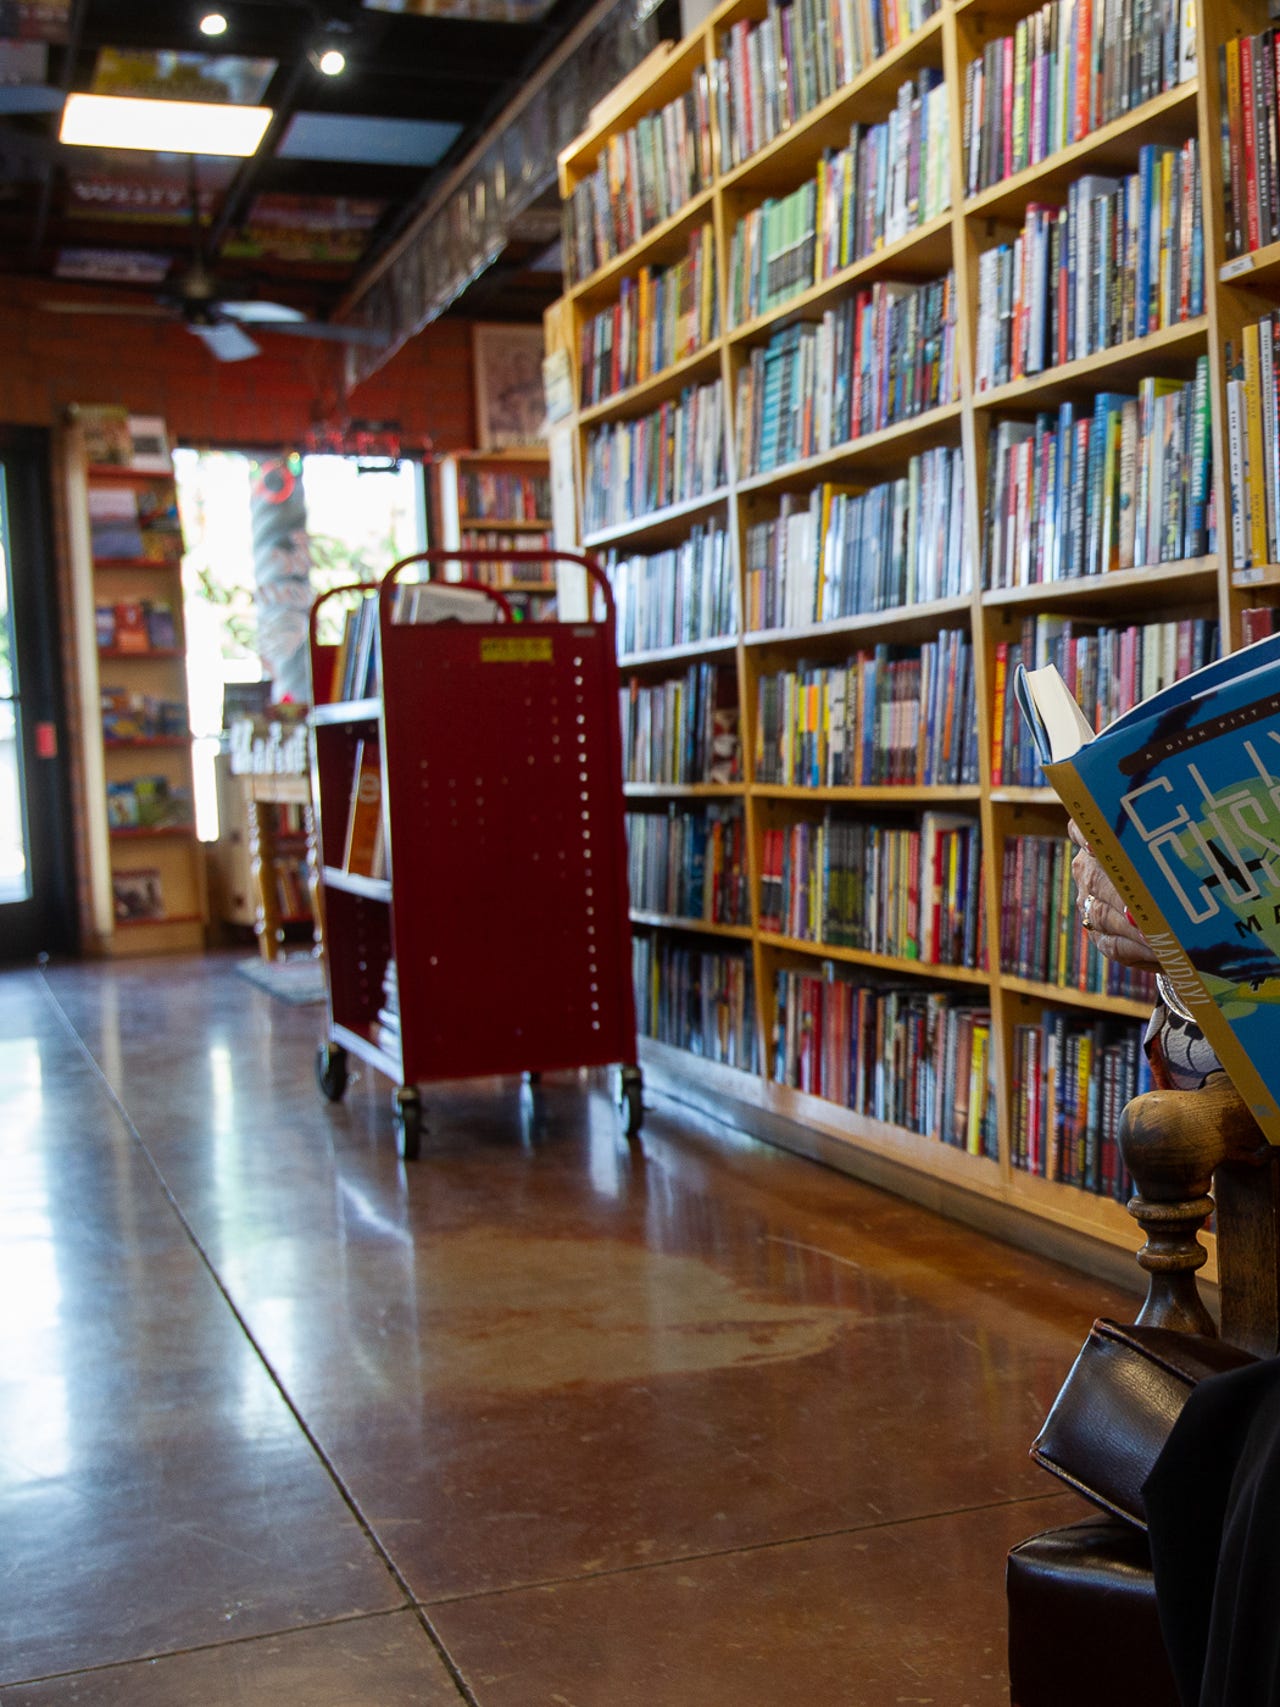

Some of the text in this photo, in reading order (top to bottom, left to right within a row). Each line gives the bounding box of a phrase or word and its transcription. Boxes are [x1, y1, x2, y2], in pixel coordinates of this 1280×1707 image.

[1192, 363, 1207, 498] JAMES PATTERSON
[1166, 730, 1206, 750] DIRK
[1219, 709, 1258, 728] PITT
[1073, 801, 1149, 922] CLIVE CUSSLER
[1148, 932, 1211, 1006] MAYDAY!
